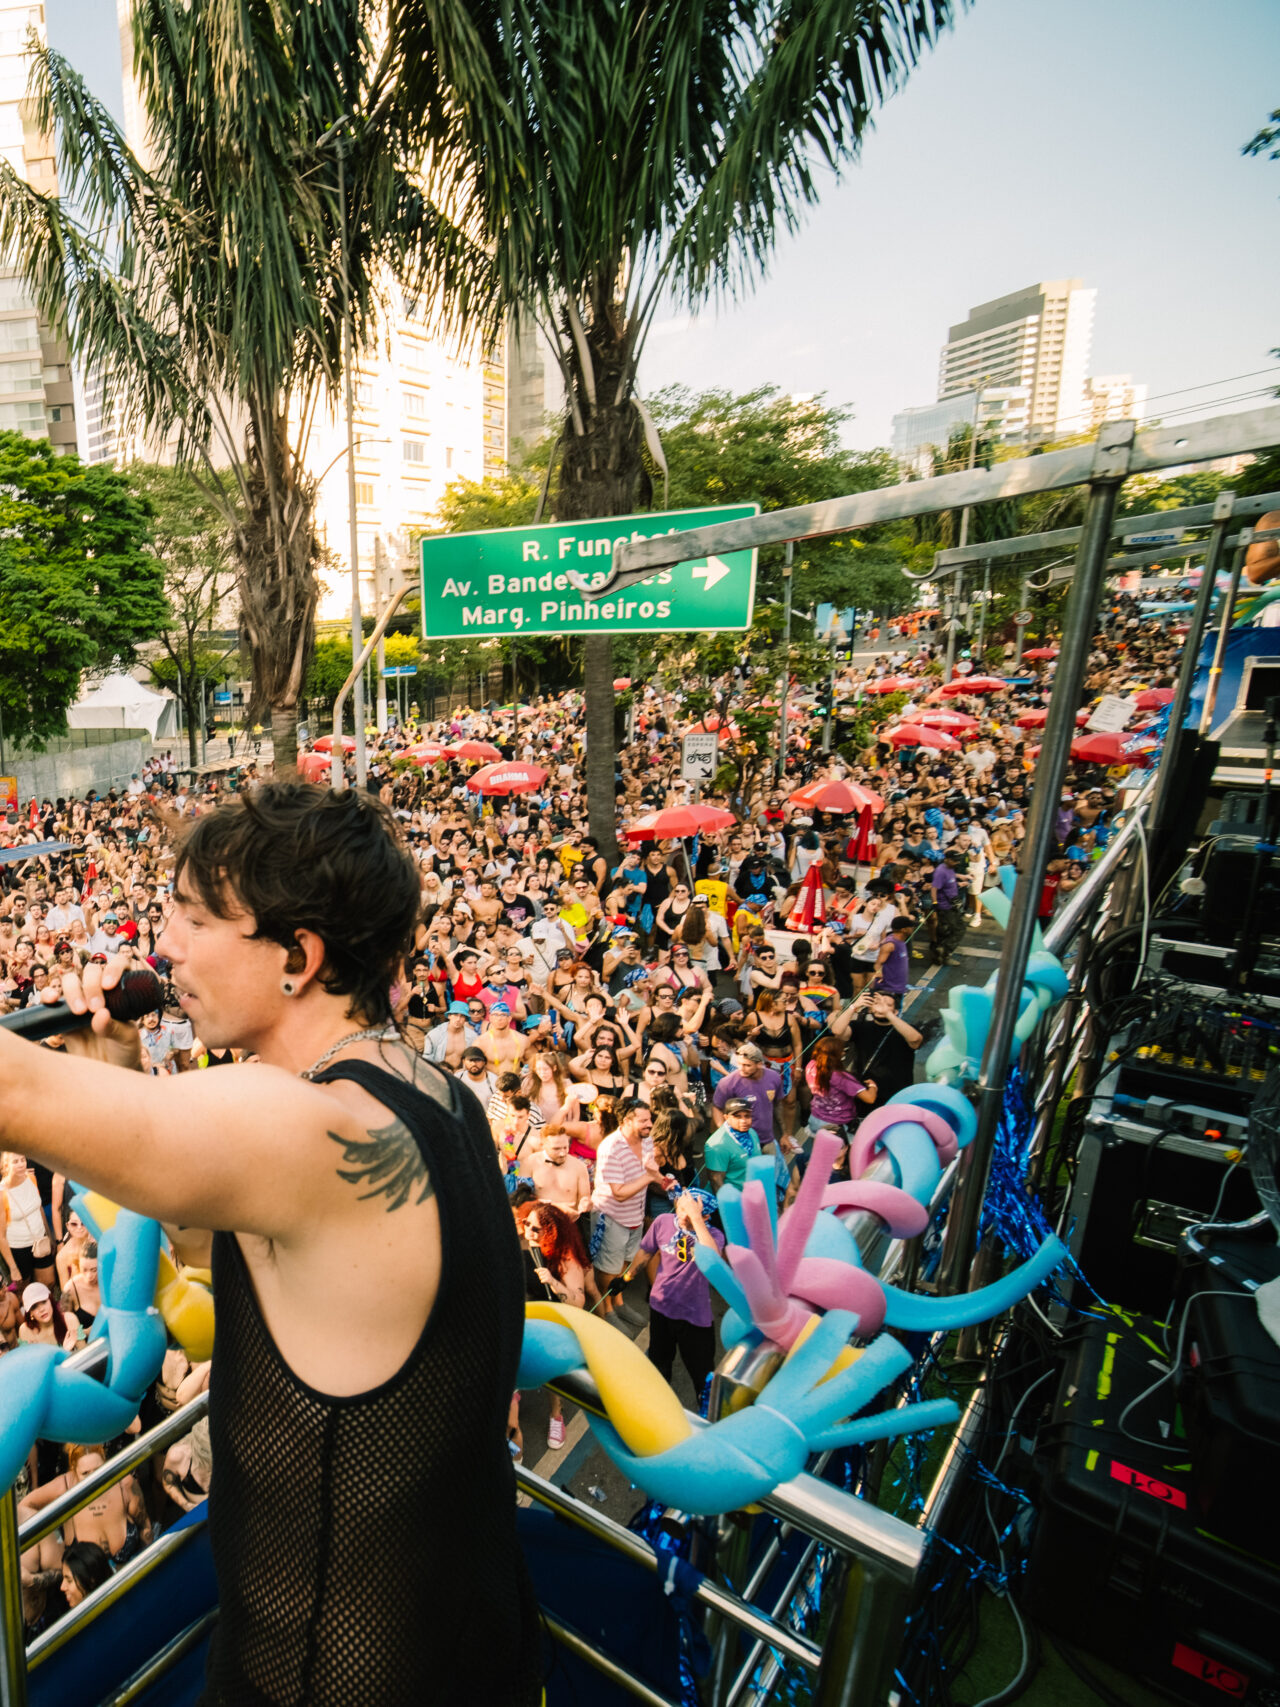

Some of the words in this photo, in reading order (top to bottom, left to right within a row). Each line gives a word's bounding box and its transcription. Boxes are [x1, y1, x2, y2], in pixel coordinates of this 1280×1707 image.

[522, 540, 550, 562] R.
[441, 577, 479, 598] Av.
[462, 605, 531, 630] Marg.
[541, 597, 671, 622] Pinheiros
